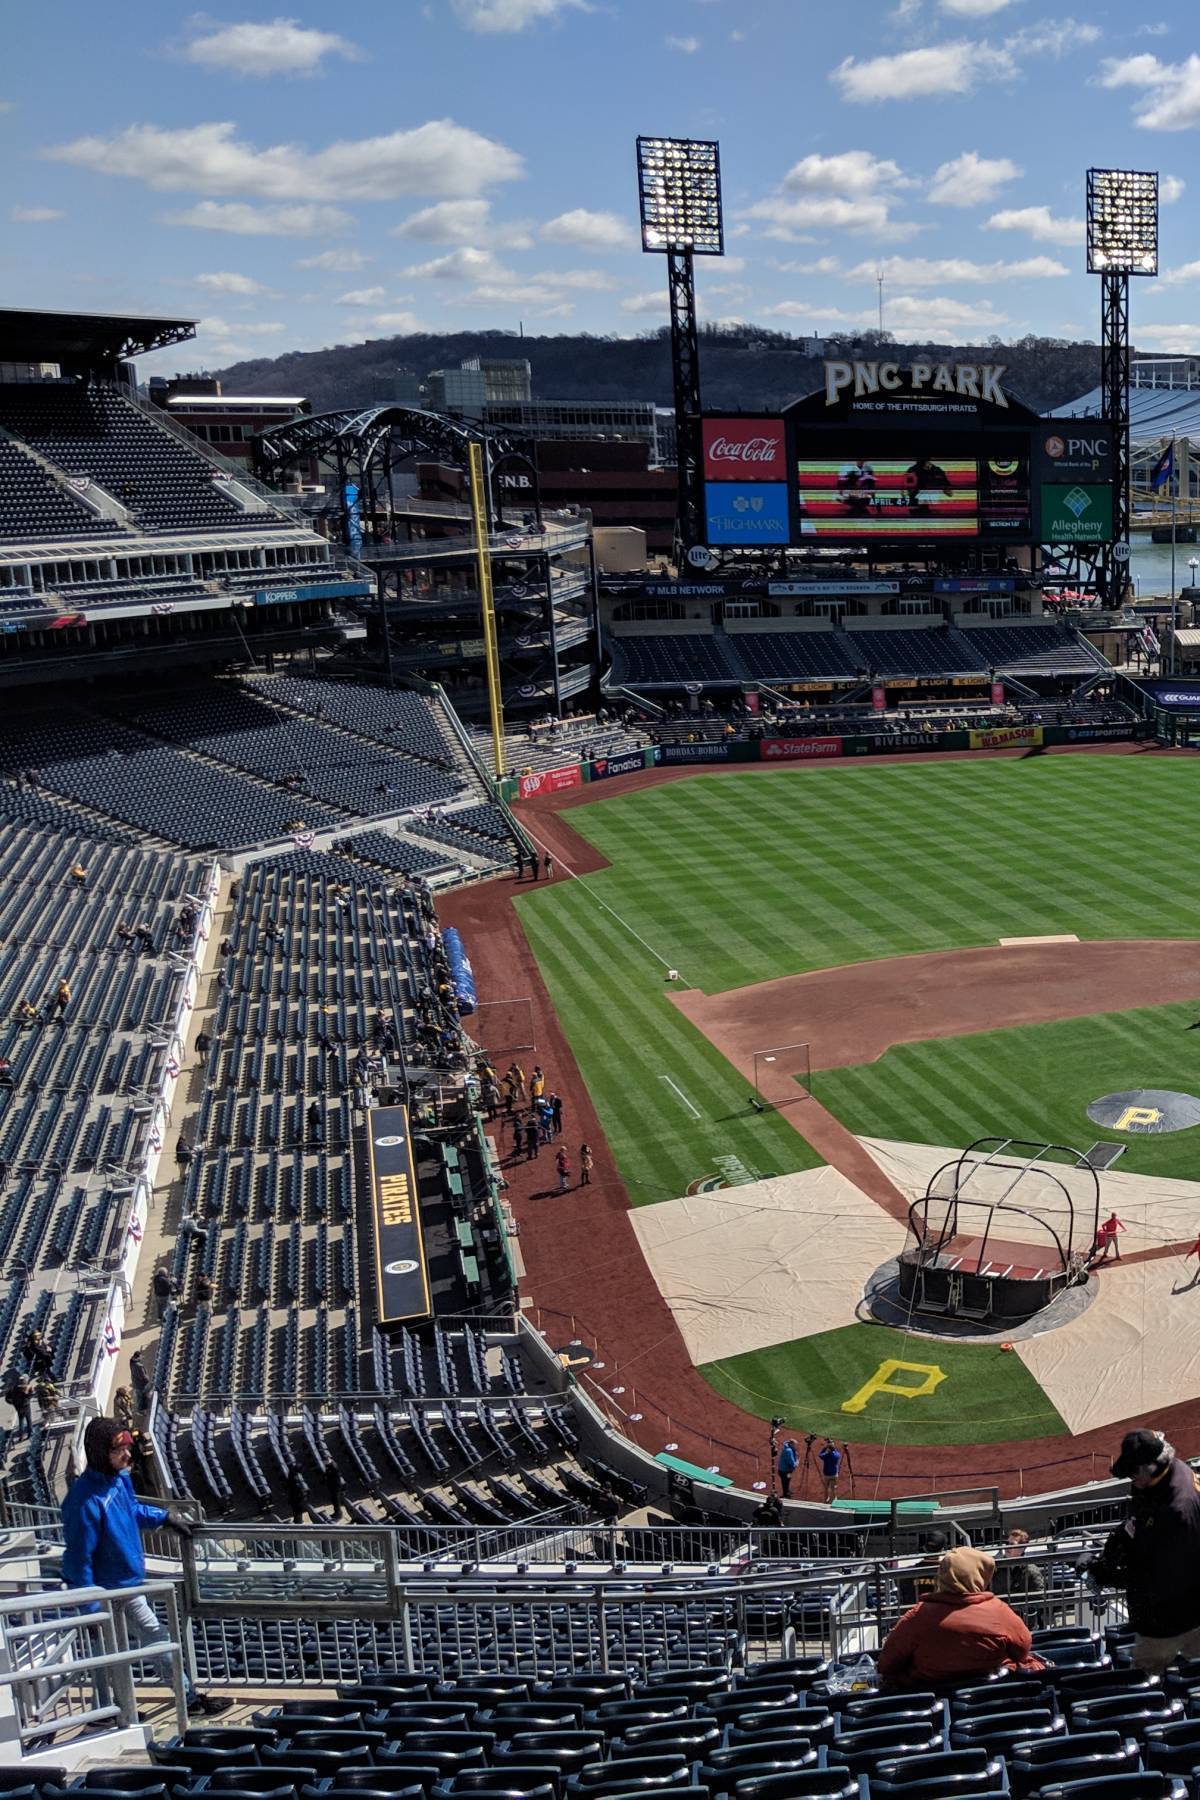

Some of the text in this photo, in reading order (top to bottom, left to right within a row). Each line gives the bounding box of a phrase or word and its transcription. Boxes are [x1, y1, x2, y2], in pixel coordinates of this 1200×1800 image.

[824, 360, 1009, 409] PNC PARK
[852, 402, 874, 410] HOME
[887, 403, 902, 411] THE
[902, 404, 948, 412] PITTSBURGH
[948, 404, 978, 413] PIRATES
[709, 437, 780, 462] Coca-Cola
[1067, 439, 1108, 457] PNC
[869, 498, 911, 506] APRIL 4-7
[1051, 519, 1103, 533] Allegheny
[1051, 532, 1073, 540] Health
[690, 550, 712, 562] Lite
[265, 590, 297, 603] KOPPERS
[657, 585, 725, 595] MLB NETWORK
[874, 734, 939, 747] RIVENDALE
[608, 757, 642, 775] Fanatics
[1112, 1106, 1165, 1131] P
[380, 1172, 413, 1226] PIRATES
[840, 1358, 949, 1414] P
